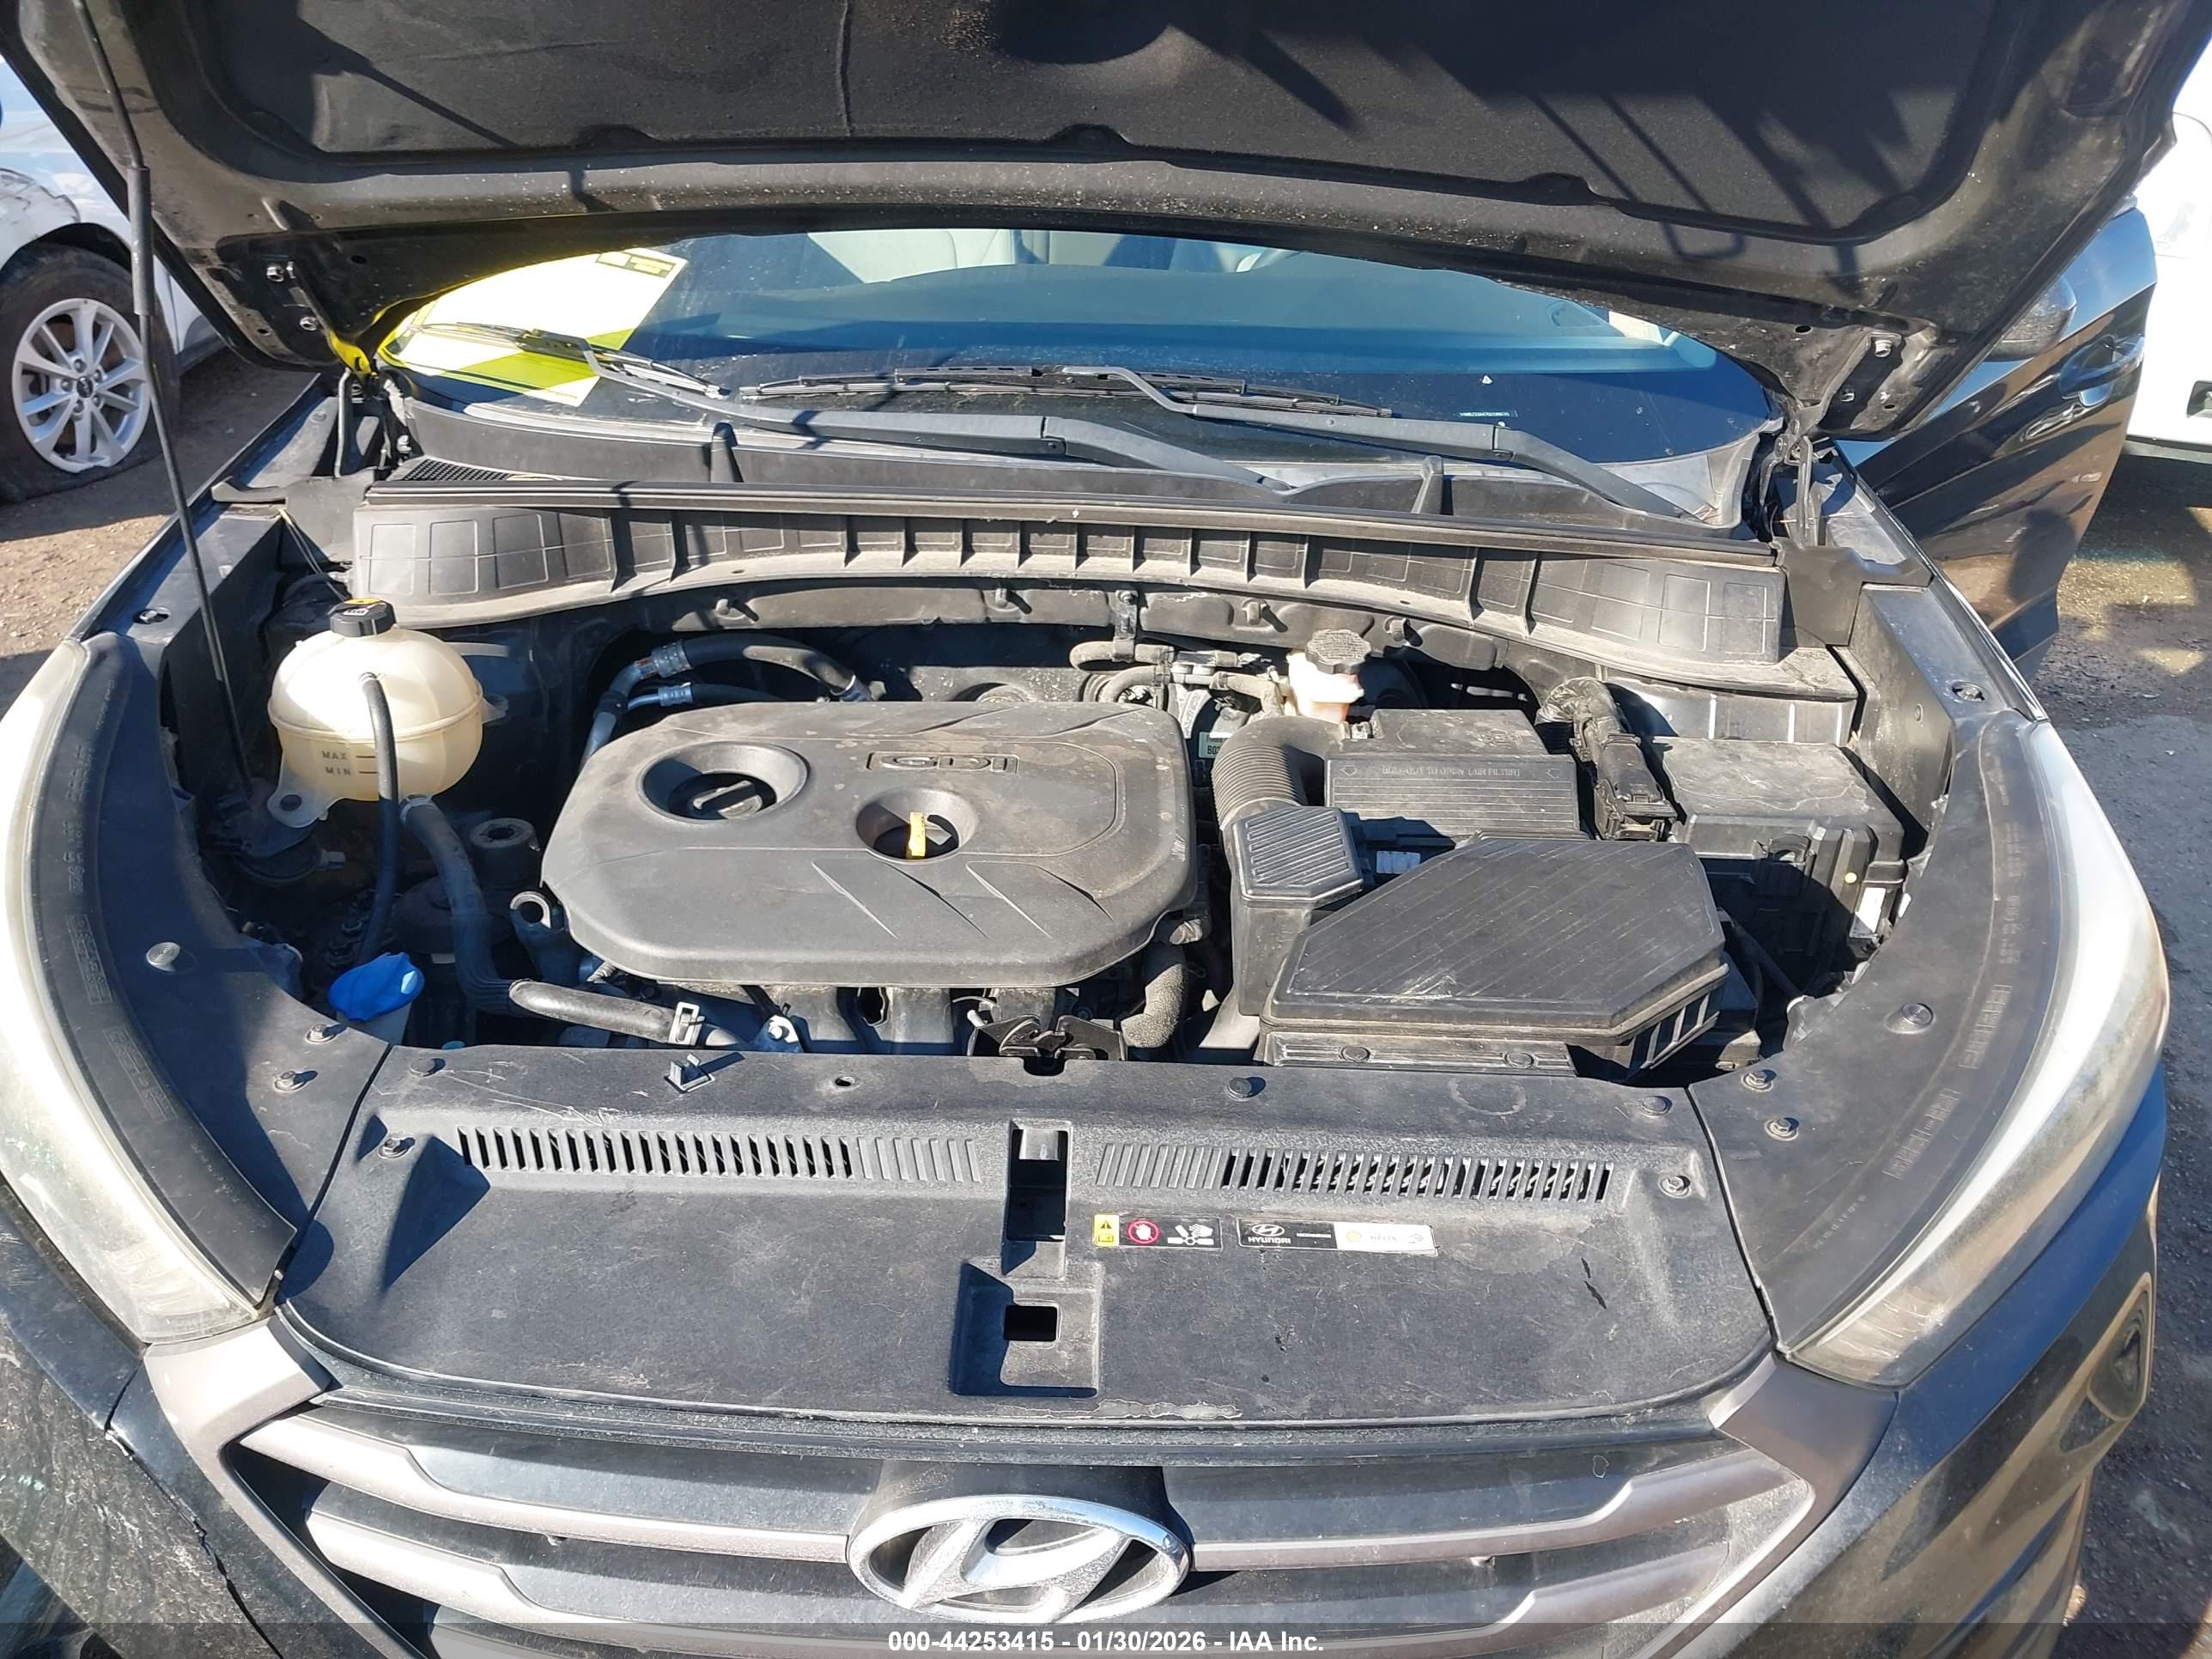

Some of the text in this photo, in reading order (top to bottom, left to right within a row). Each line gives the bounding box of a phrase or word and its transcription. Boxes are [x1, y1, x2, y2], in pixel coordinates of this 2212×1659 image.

[321, 750, 347, 759] MAX
[325, 767, 350, 775] MIN
[1248, 1236, 1291, 1244] HYUNDAI
